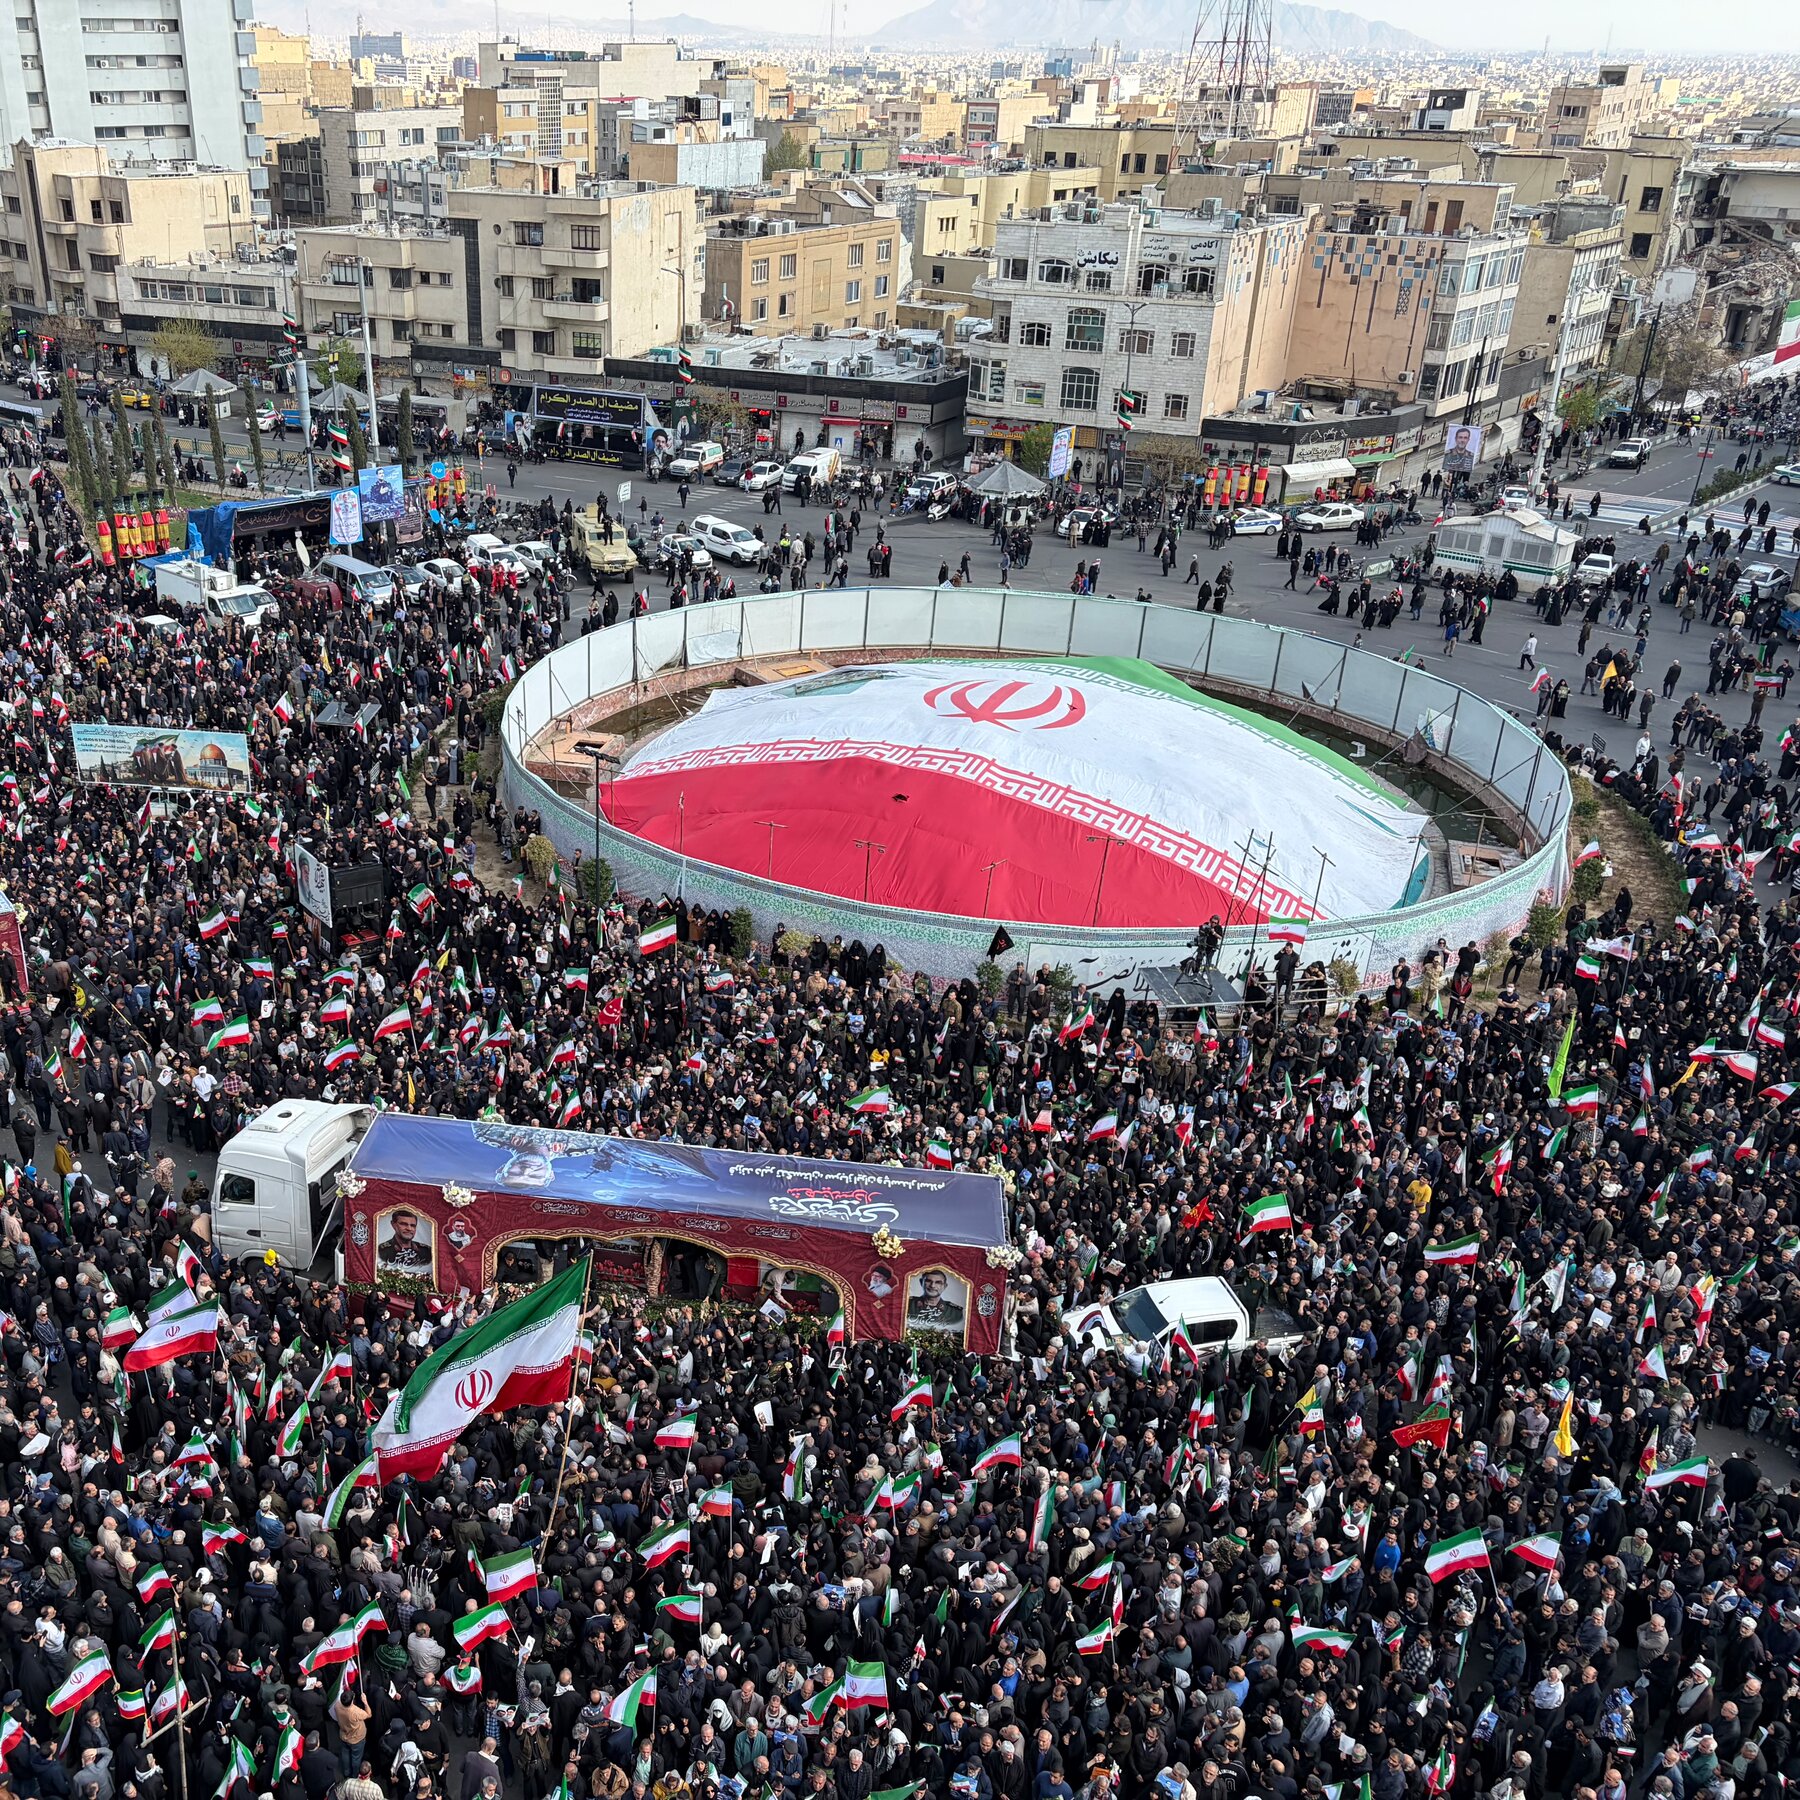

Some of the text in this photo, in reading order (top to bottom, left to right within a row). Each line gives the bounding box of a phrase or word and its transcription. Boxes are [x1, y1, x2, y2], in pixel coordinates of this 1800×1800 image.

[1190, 240, 1219, 250] آکادمی
[1076, 251, 1119, 268] نیکایش
[572, 396, 597, 406] الصدر
[728, 1165, 754, 1176] فرزند
[755, 1165, 776, 1177] دلیر
[825, 1173, 852, 1183] سرباز
[852, 1174, 876, 1184] ایران
[883, 1177, 916, 1188] پاسدار
[916, 1181, 945, 1191] اسلام
